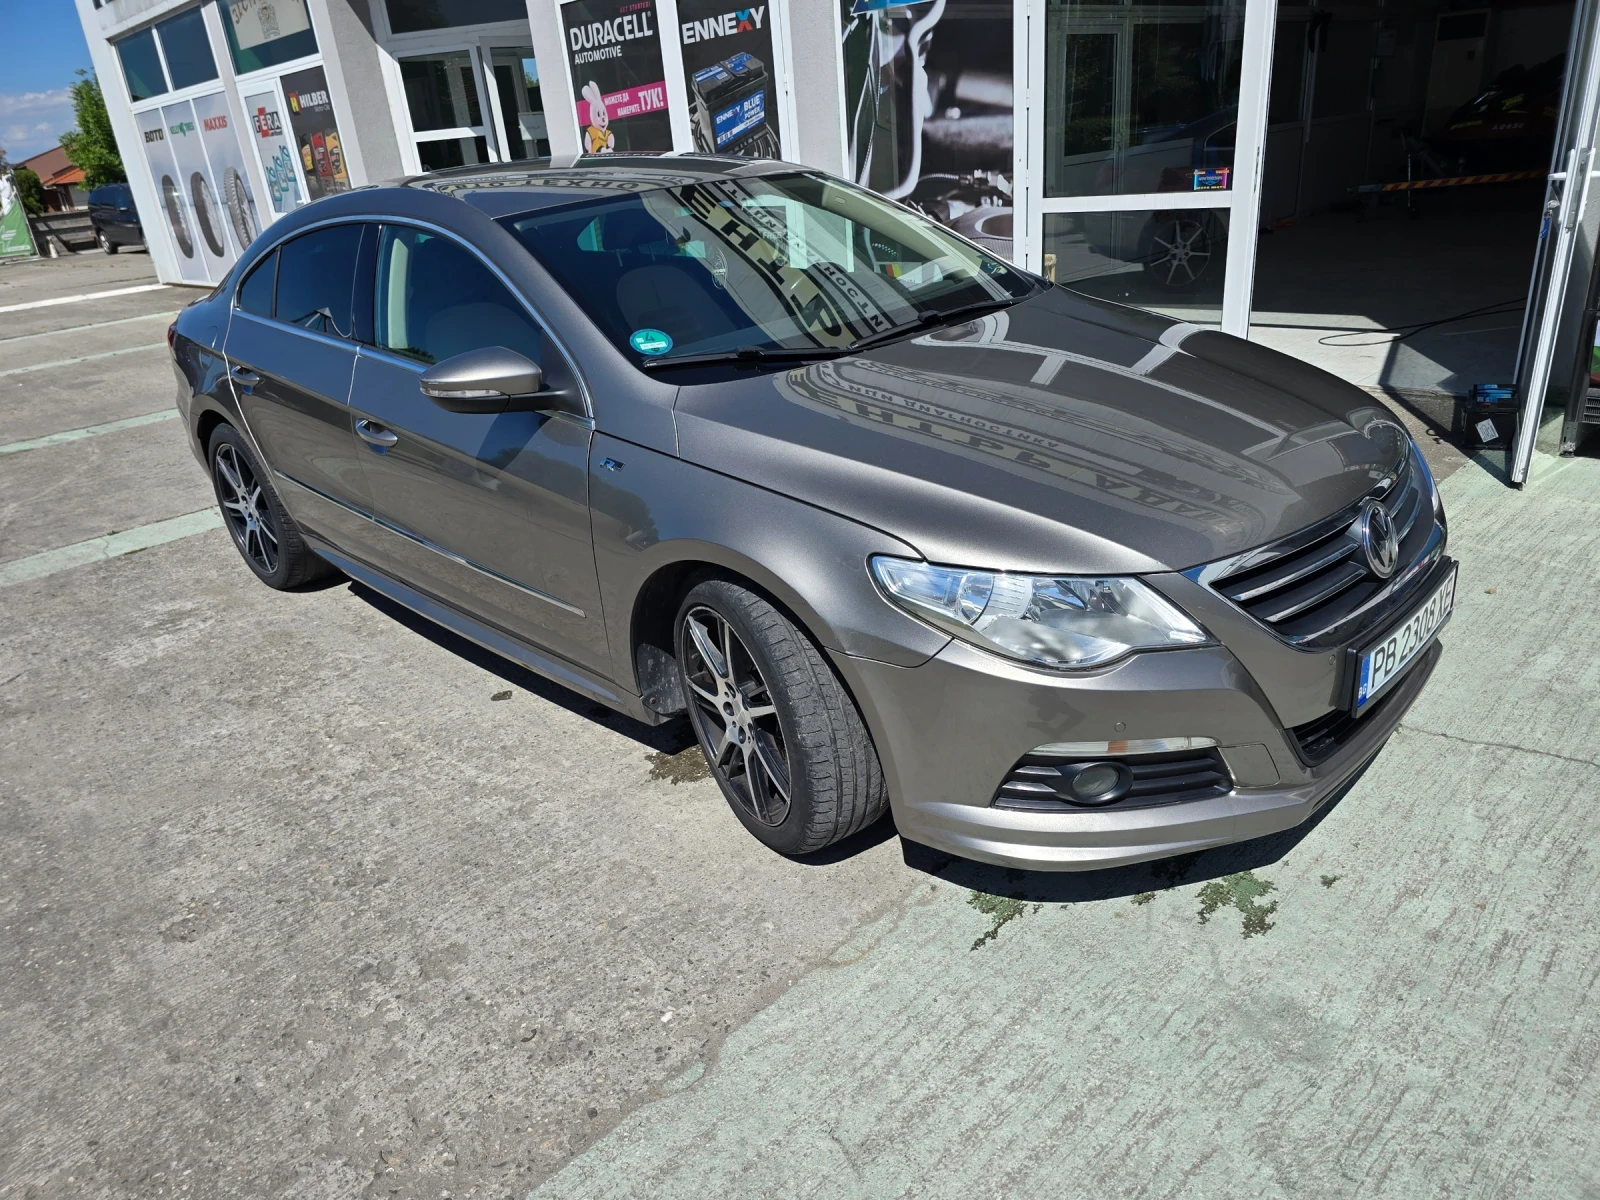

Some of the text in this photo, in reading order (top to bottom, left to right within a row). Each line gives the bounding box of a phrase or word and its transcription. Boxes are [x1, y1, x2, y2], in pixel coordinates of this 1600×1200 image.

[570, 11, 653, 51] DURACELL
[682, 6, 765, 44] ENNEXY
[575, 45, 622, 65] AUTOMOTIVE
[299, 90, 329, 109] HILBER
[622, 92, 630, 103] ДА
[638, 87, 664, 111] ТУК!
[743, 94, 761, 111] BLUE
[254, 111, 282, 133] FERA
[716, 105, 740, 124] ENNEXY
[744, 107, 761, 120] POWER
[203, 115, 228, 132] MAXXIS
[144, 128, 164, 143] BOTO
[1371, 637, 1397, 689] PB
[1399, 597, 1437, 665] 2308
[1358, 683, 1368, 698] BG
